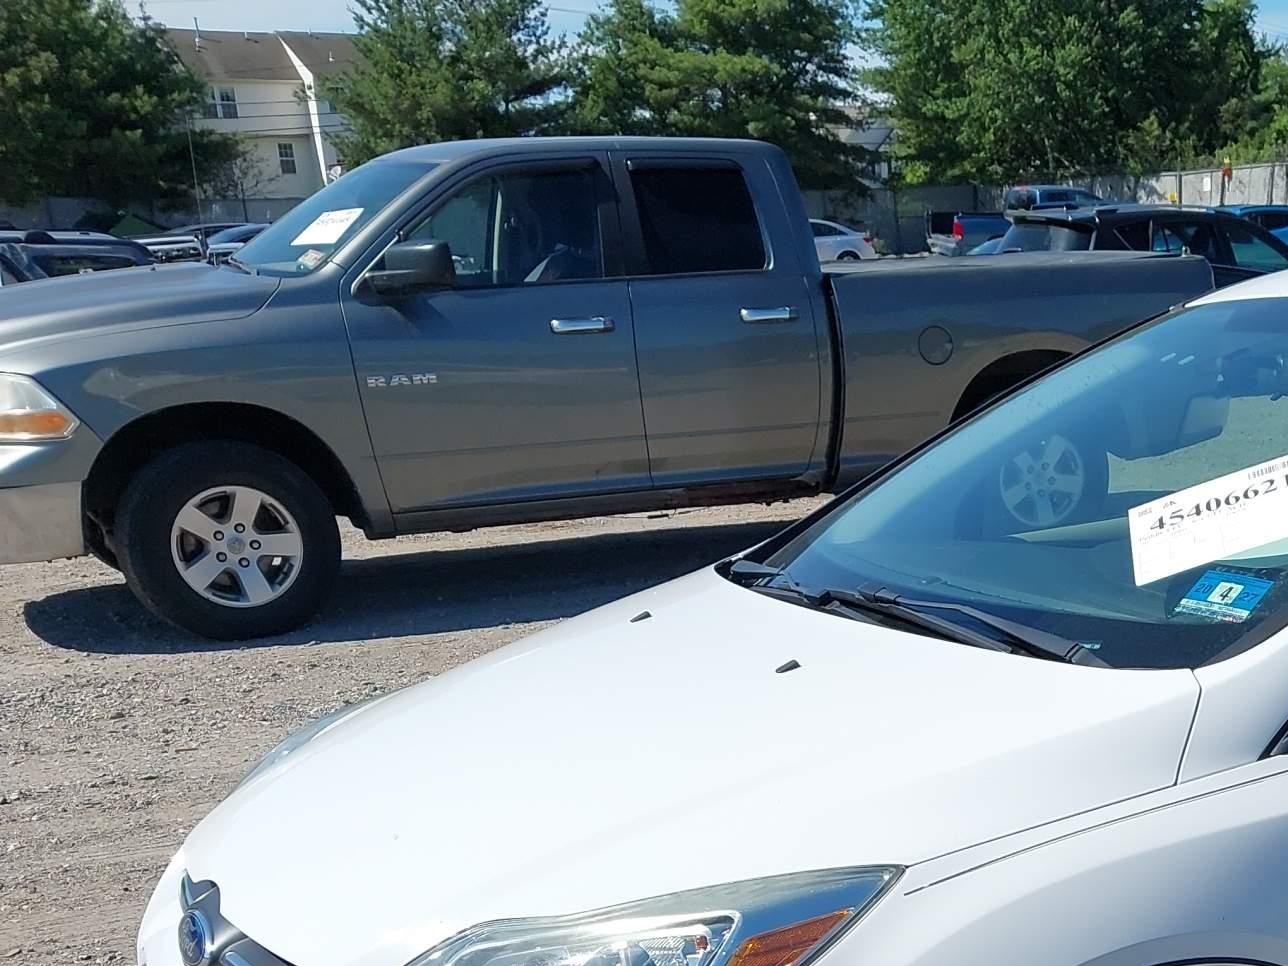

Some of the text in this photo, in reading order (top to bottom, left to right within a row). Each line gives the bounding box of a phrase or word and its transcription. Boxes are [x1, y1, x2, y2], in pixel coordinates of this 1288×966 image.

[366, 374, 438, 387] RAM
[1195, 583, 1258, 601] 20 4 27
